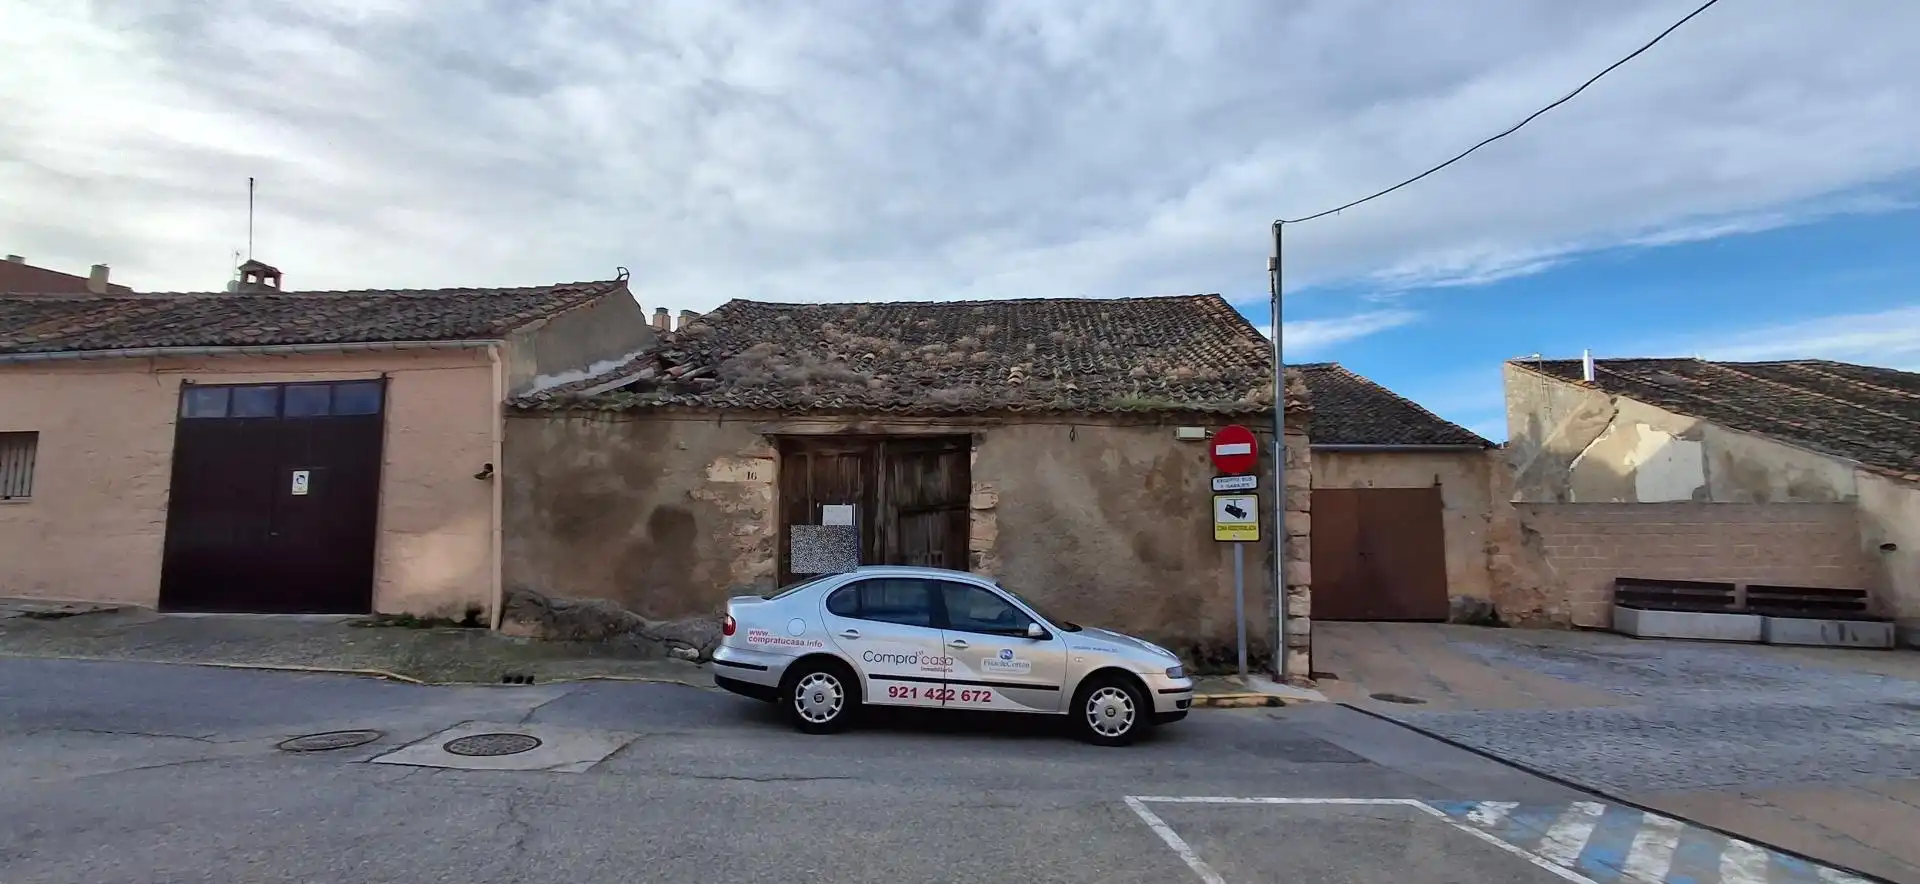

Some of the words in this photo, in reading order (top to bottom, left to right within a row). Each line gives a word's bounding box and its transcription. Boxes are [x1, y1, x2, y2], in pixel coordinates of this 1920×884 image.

[746, 471, 757, 480] 16
[748, 636, 823, 648] compratucasa.info
[863, 650, 917, 665] Compra
[921, 655, 954, 666] casa
[888, 686, 917, 698] 921
[924, 688, 955, 701] 422
[961, 689, 992, 702] 672
